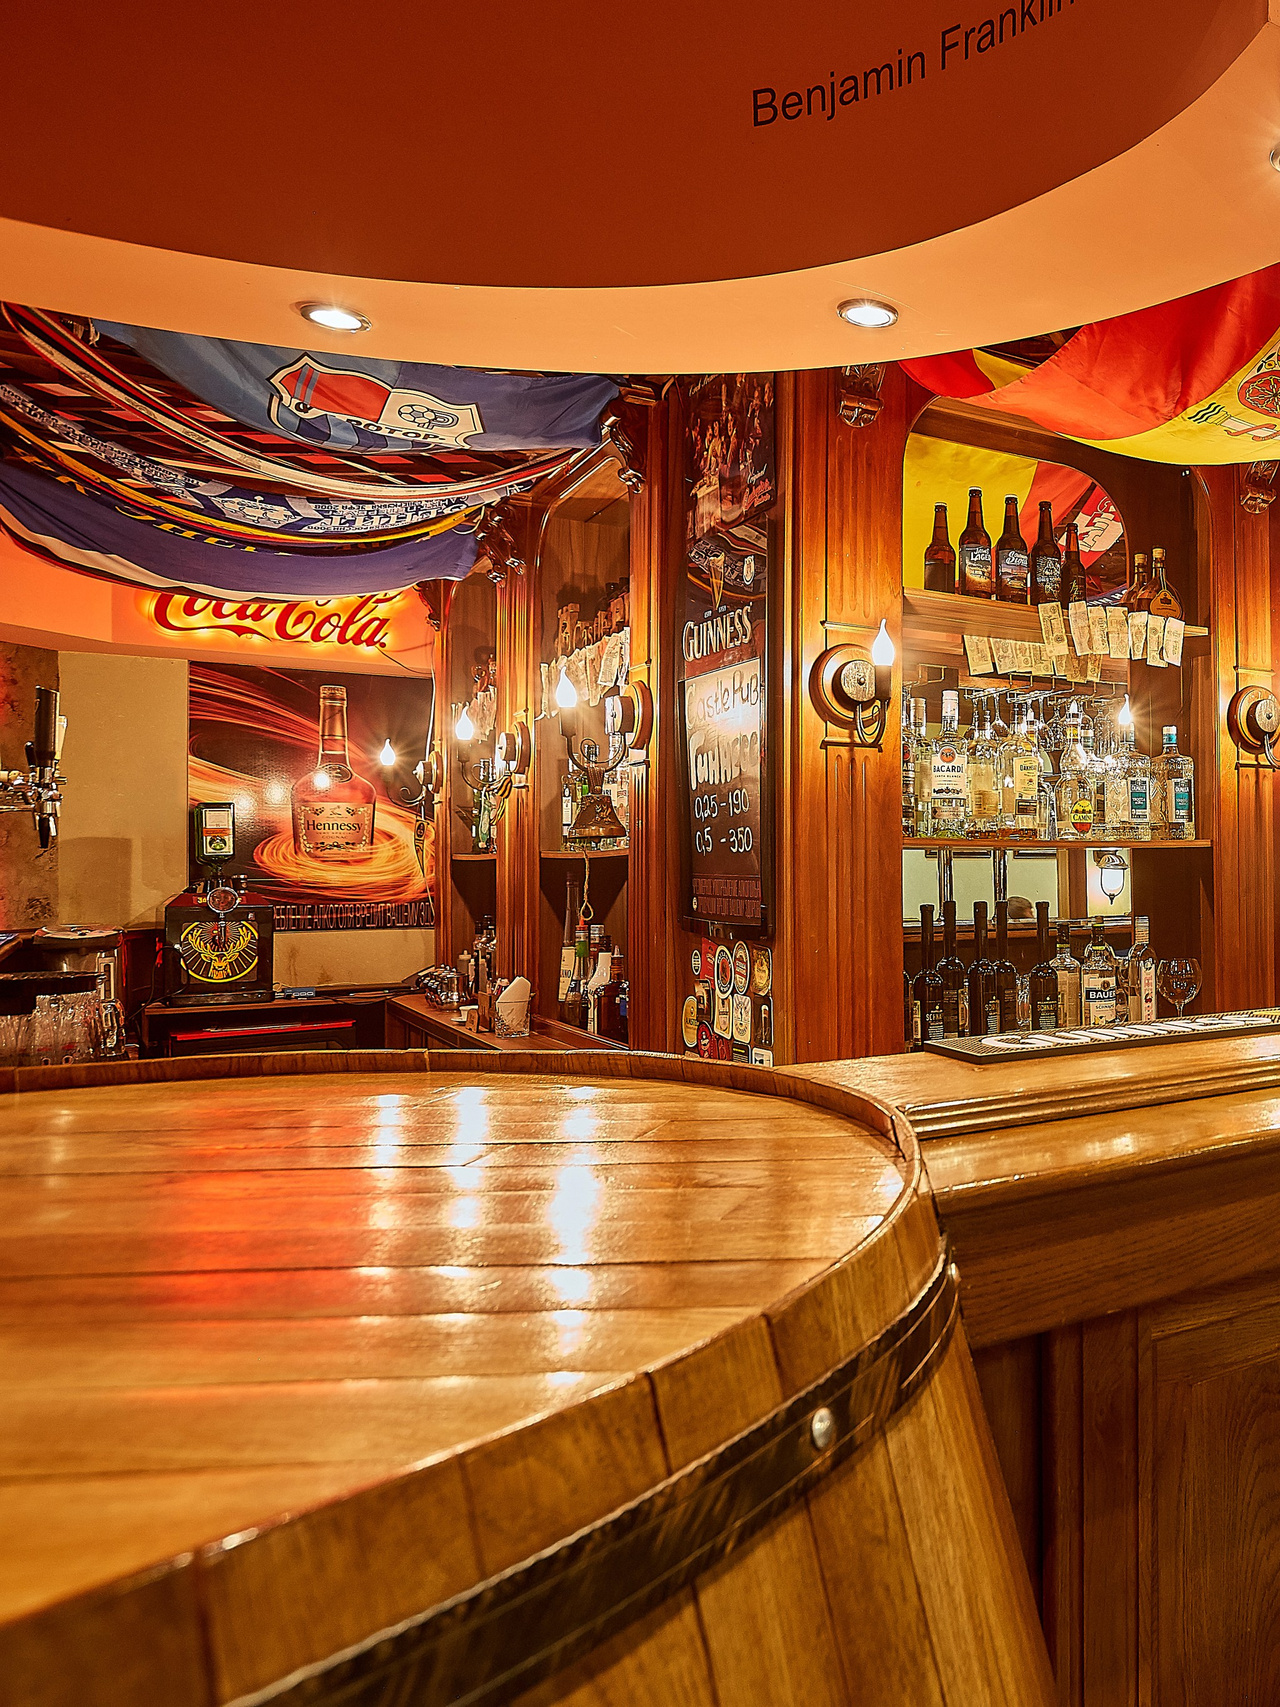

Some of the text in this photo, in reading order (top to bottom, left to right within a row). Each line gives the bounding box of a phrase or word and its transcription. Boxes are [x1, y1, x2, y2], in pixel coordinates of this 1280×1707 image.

[752, 48, 926, 127] Benjamin
[154, 592, 404, 648] CocaCola
[683, 605, 752, 662] GUINNESS
[306, 819, 363, 834] Hennessy
[314, 903, 355, 929] АЛКОГОЛЯ
[355, 903, 386, 928] ВРЕДИТ
[386, 902, 419, 927] ВАШЕМУ
[981, 1013, 1273, 1048] GUINNESS
